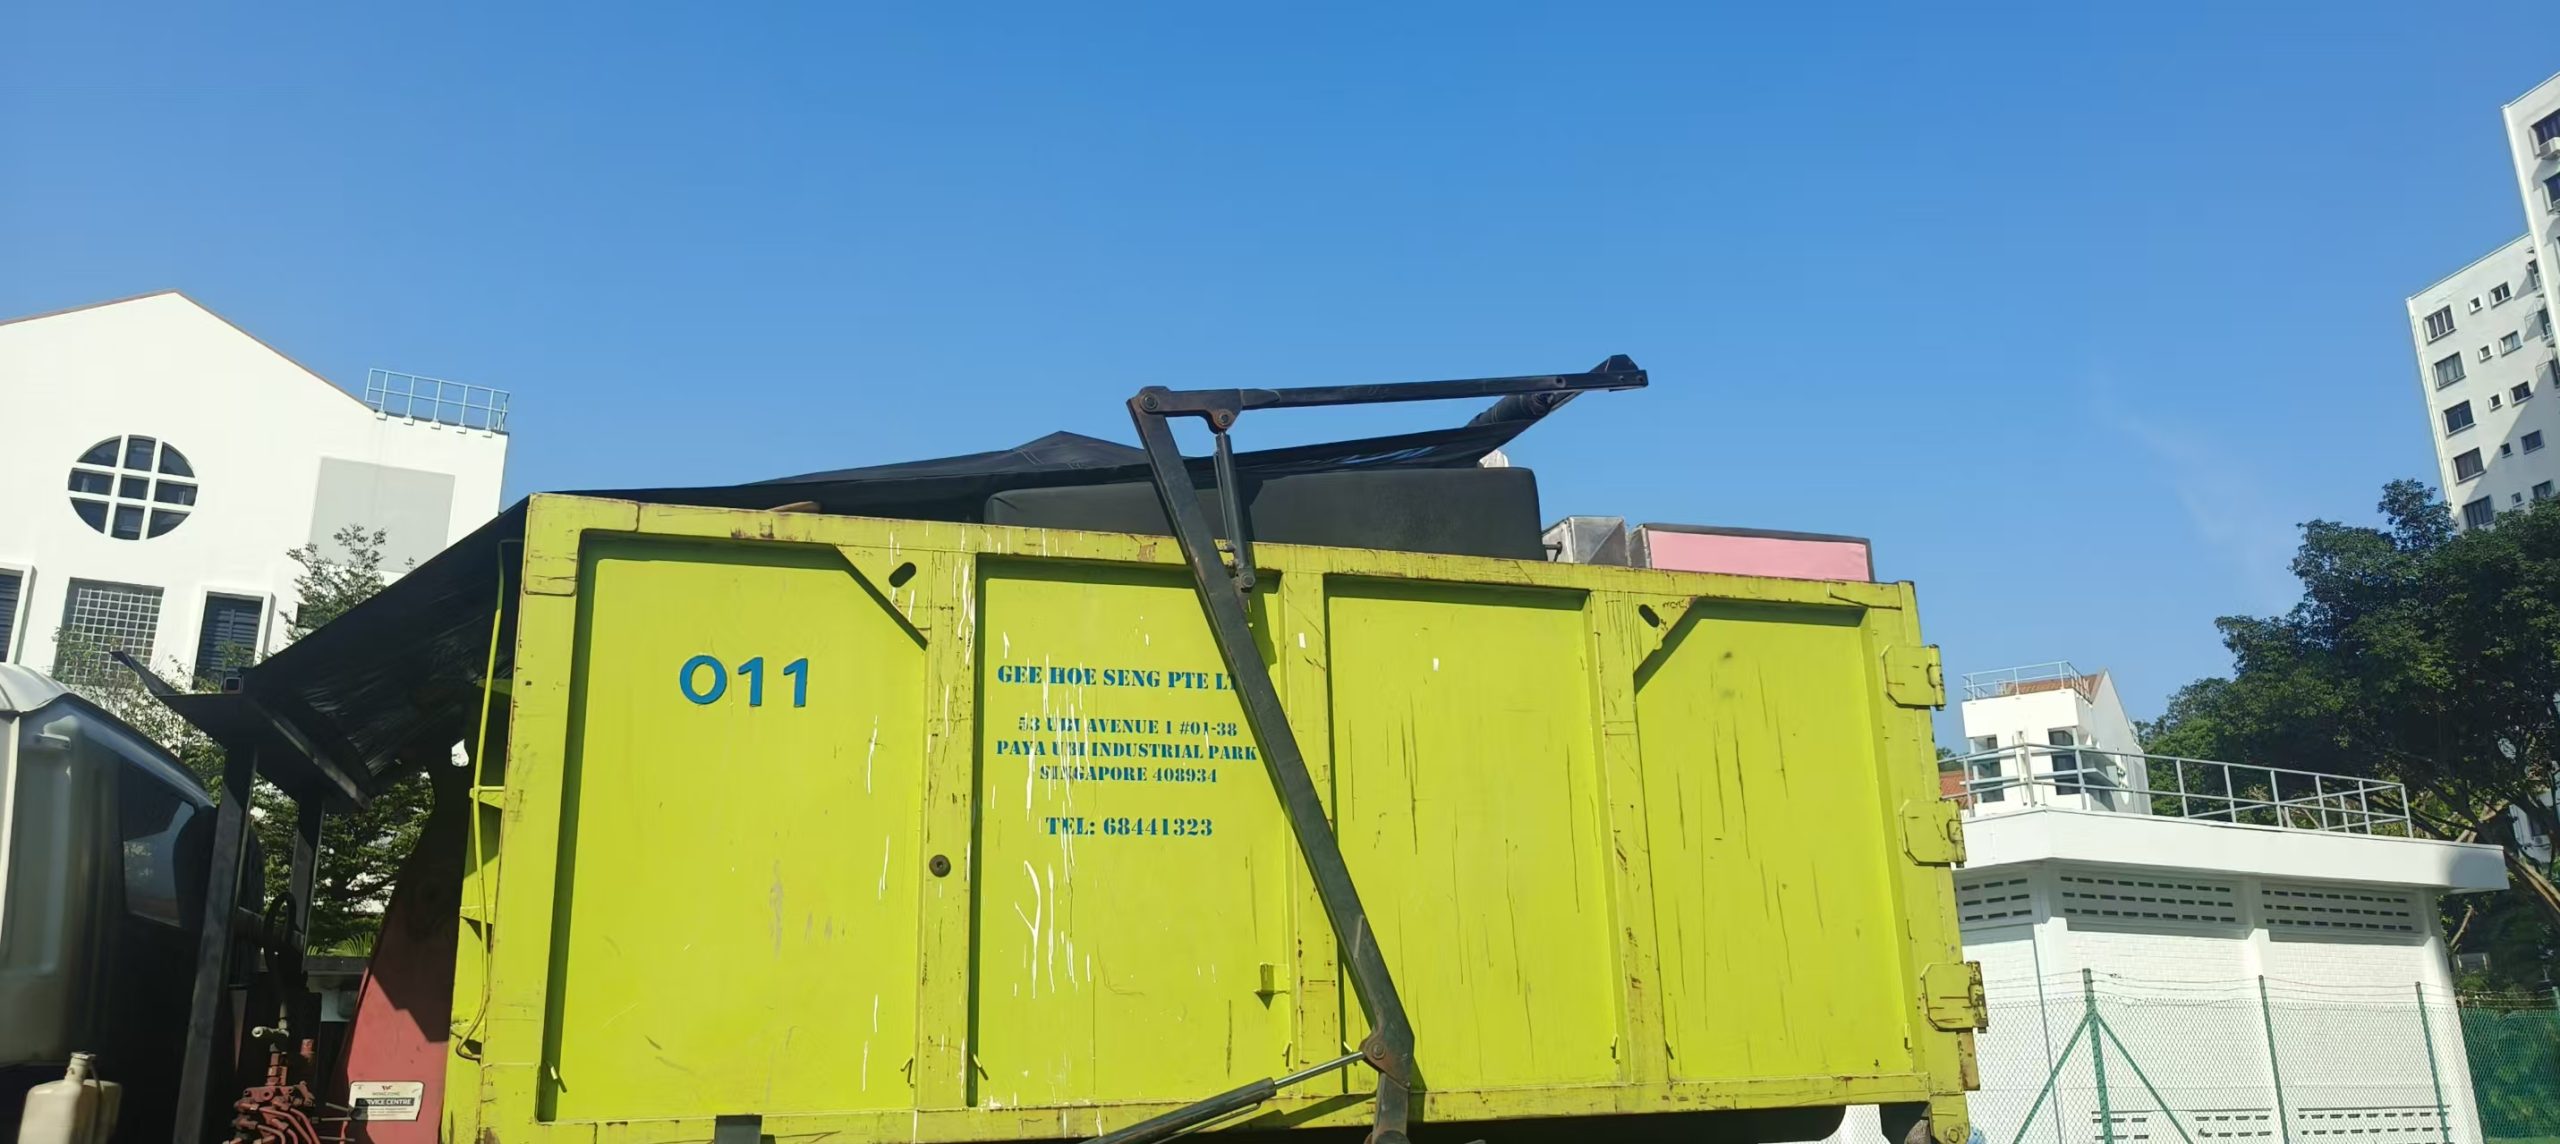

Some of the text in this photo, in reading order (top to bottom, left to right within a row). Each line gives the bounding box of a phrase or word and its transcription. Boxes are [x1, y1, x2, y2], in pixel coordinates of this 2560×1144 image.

[680, 655, 808, 708] 011
[997, 665, 1042, 683] GEE
[1050, 666, 1096, 685] HOE
[1103, 669, 1160, 687] SENG
[1168, 671, 1208, 689] PTE
[1018, 717, 1237, 736] 53 UBI AVENUE 1 #01-38
[996, 741, 1257, 760] PAYA UBI INDUSTRIAL PARK
[1040, 765, 1217, 782] SINGAPORE 408934
[1046, 817, 1213, 836] TEL: 68441323
